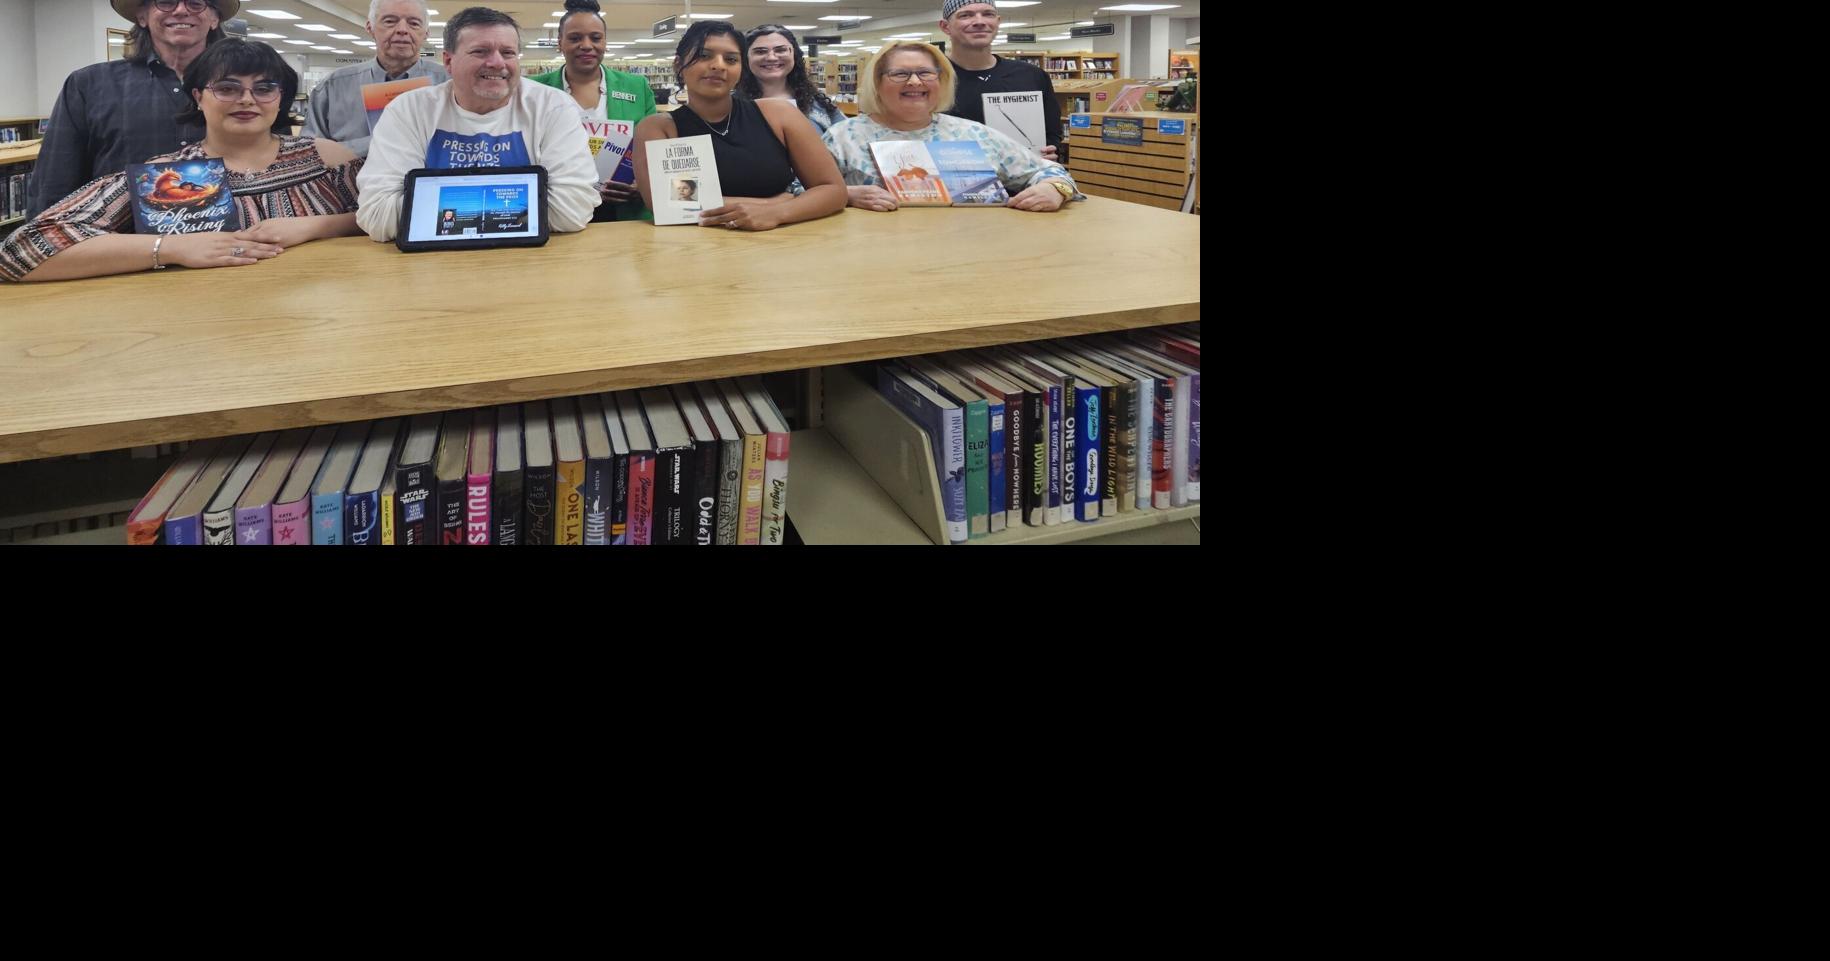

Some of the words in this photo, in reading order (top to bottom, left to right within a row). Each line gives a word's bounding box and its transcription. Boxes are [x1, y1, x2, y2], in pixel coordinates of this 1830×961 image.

[987, 96, 1001, 104] THE
[1003, 95, 1039, 103] HYGIENIST
[443, 139, 489, 152] PRESSIG
[492, 141, 511, 152] ON
[665, 148, 674, 158] LA
[674, 146, 694, 157] FORMA
[449, 151, 500, 163] TOWRDS
[662, 160, 670, 170] DE
[671, 157, 701, 170] QUEDARSE
[147, 205, 231, 226] Phoenix
[157, 219, 225, 235] Rising
[1108, 415, 1117, 425] IN
[951, 415, 963, 463] INKFLOWER
[1065, 417, 1075, 449] ONE
[1109, 426, 1117, 442] THE
[968, 440, 988, 450] ELIZA
[1051, 431, 1059, 462] EVERYTHING
[1107, 446, 1117, 467] WILD
[673, 474, 681, 494] WARS
[747, 468, 762, 480] AS
[1065, 463, 1075, 502] BOYS
[1107, 469, 1116, 498] LIGHT
[1126, 471, 1136, 494] KIN
[399, 493, 427, 504] WARS
[403, 488, 429, 498] STAR
[746, 484, 761, 502] YOU
[770, 479, 784, 510] Bingsu
[1012, 468, 1020, 510] NOWHERE
[468, 485, 487, 544] RULES
[567, 493, 579, 520] ONE
[698, 496, 714, 526] Odd
[718, 487, 732, 539] THORNY
[587, 511, 605, 545] WHIT
[673, 507, 681, 538] TRILOGY
[744, 505, 760, 533] WALK
[769, 526, 781, 543] Two
